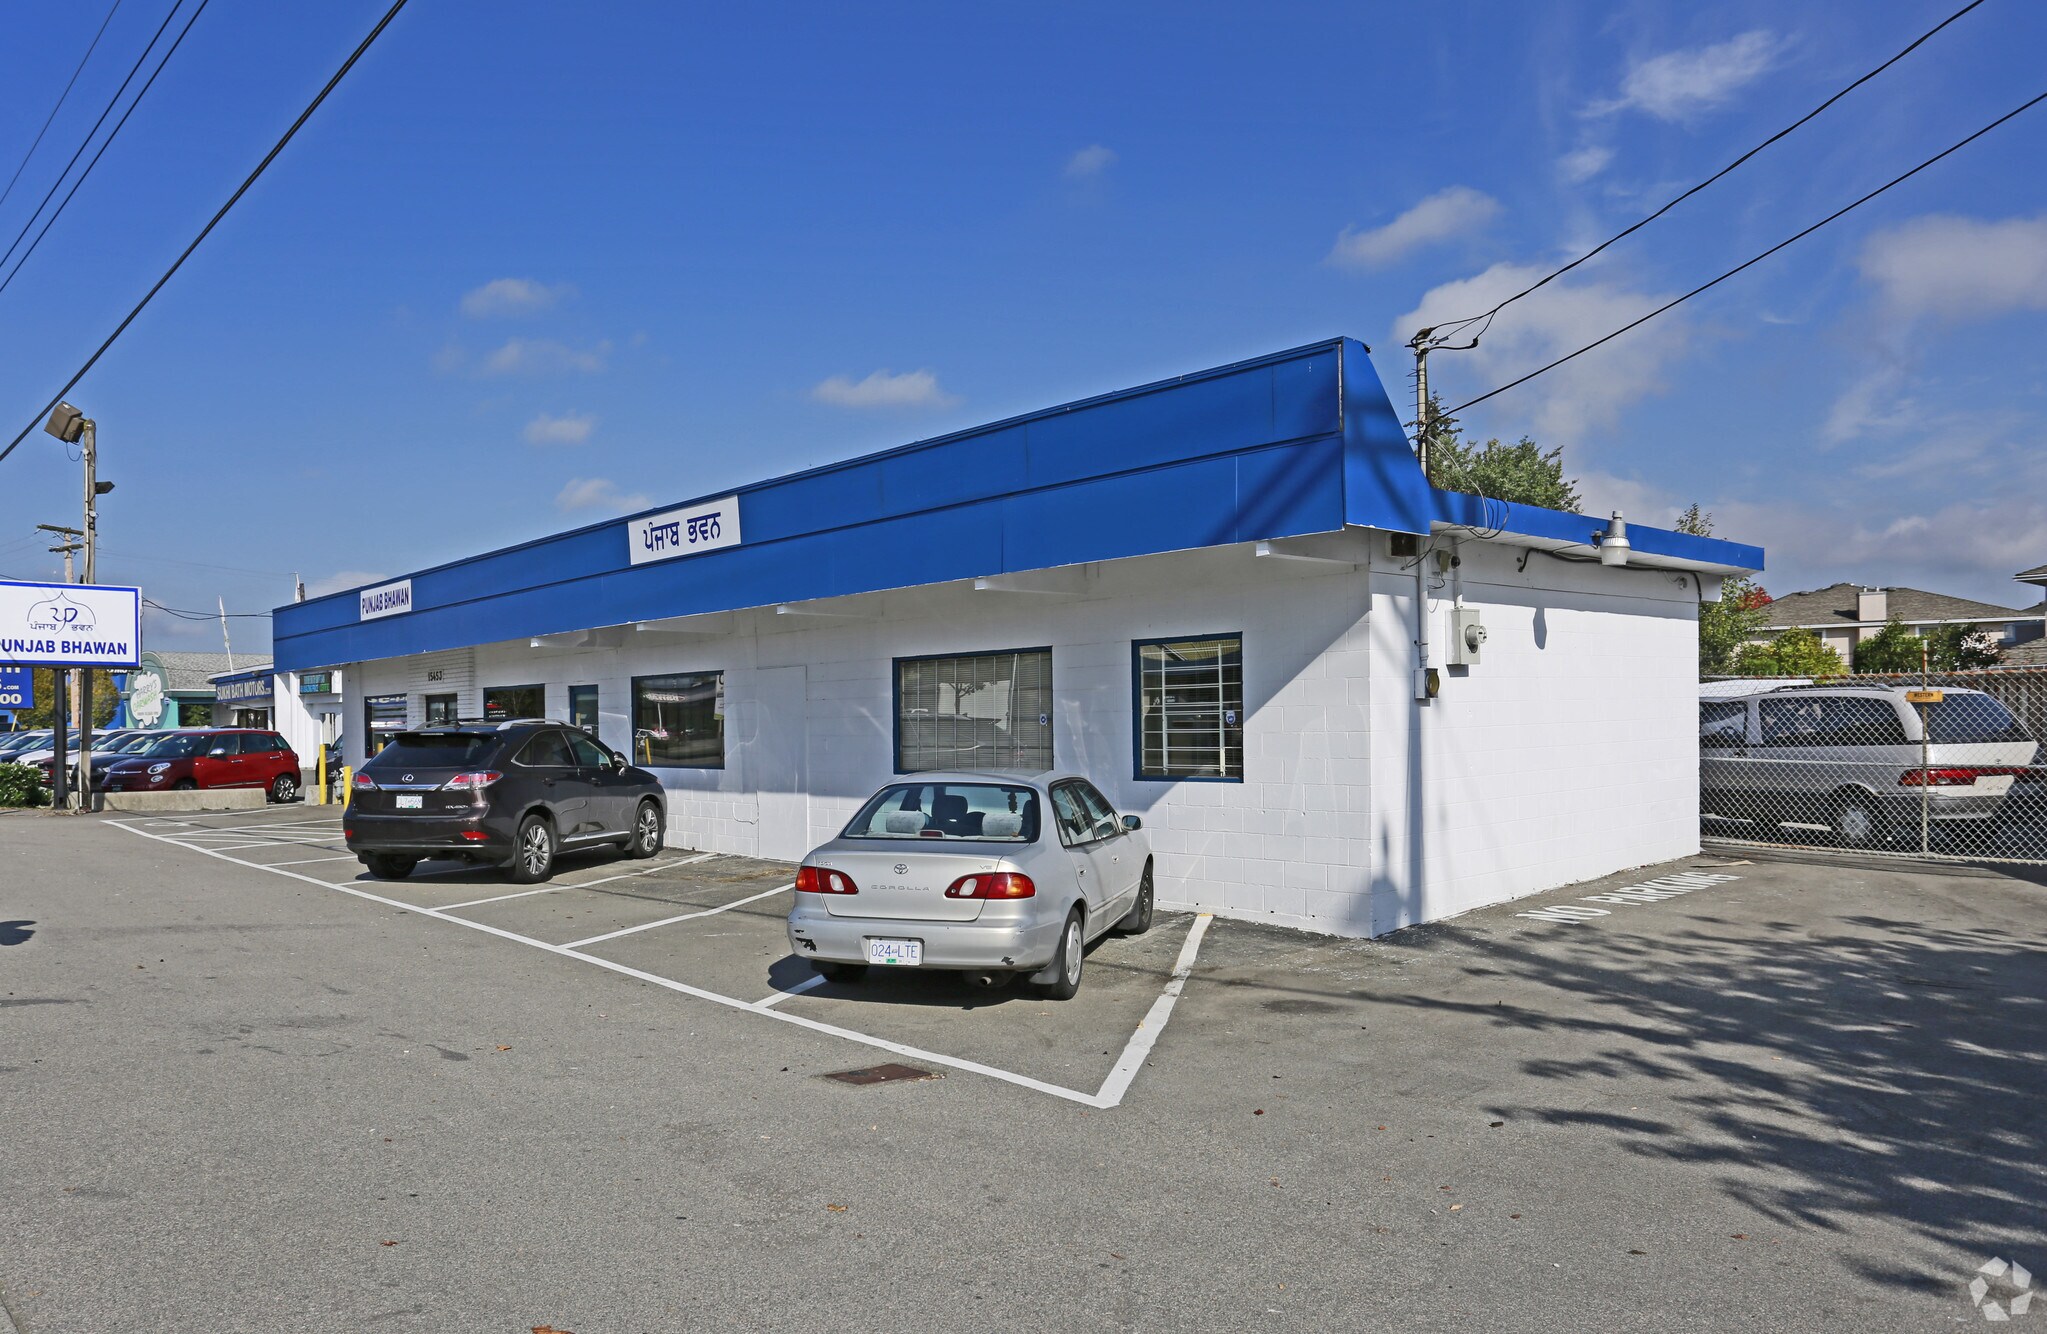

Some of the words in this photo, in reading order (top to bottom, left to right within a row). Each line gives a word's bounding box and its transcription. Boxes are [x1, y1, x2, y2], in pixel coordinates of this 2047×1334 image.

[643, 521, 680, 552] ਪੰਜਾਬ
[687, 511, 721, 544] ਭਵਨ
[362, 593, 383, 615] PUNJAB
[384, 587, 409, 610] BHAWAN
[1, 638, 56, 653] UNJAB
[61, 640, 127, 655] BHAWAN
[217, 685, 231, 700] SUKHI
[231, 683, 244, 698] BATH
[1515, 905, 1612, 925] NO
